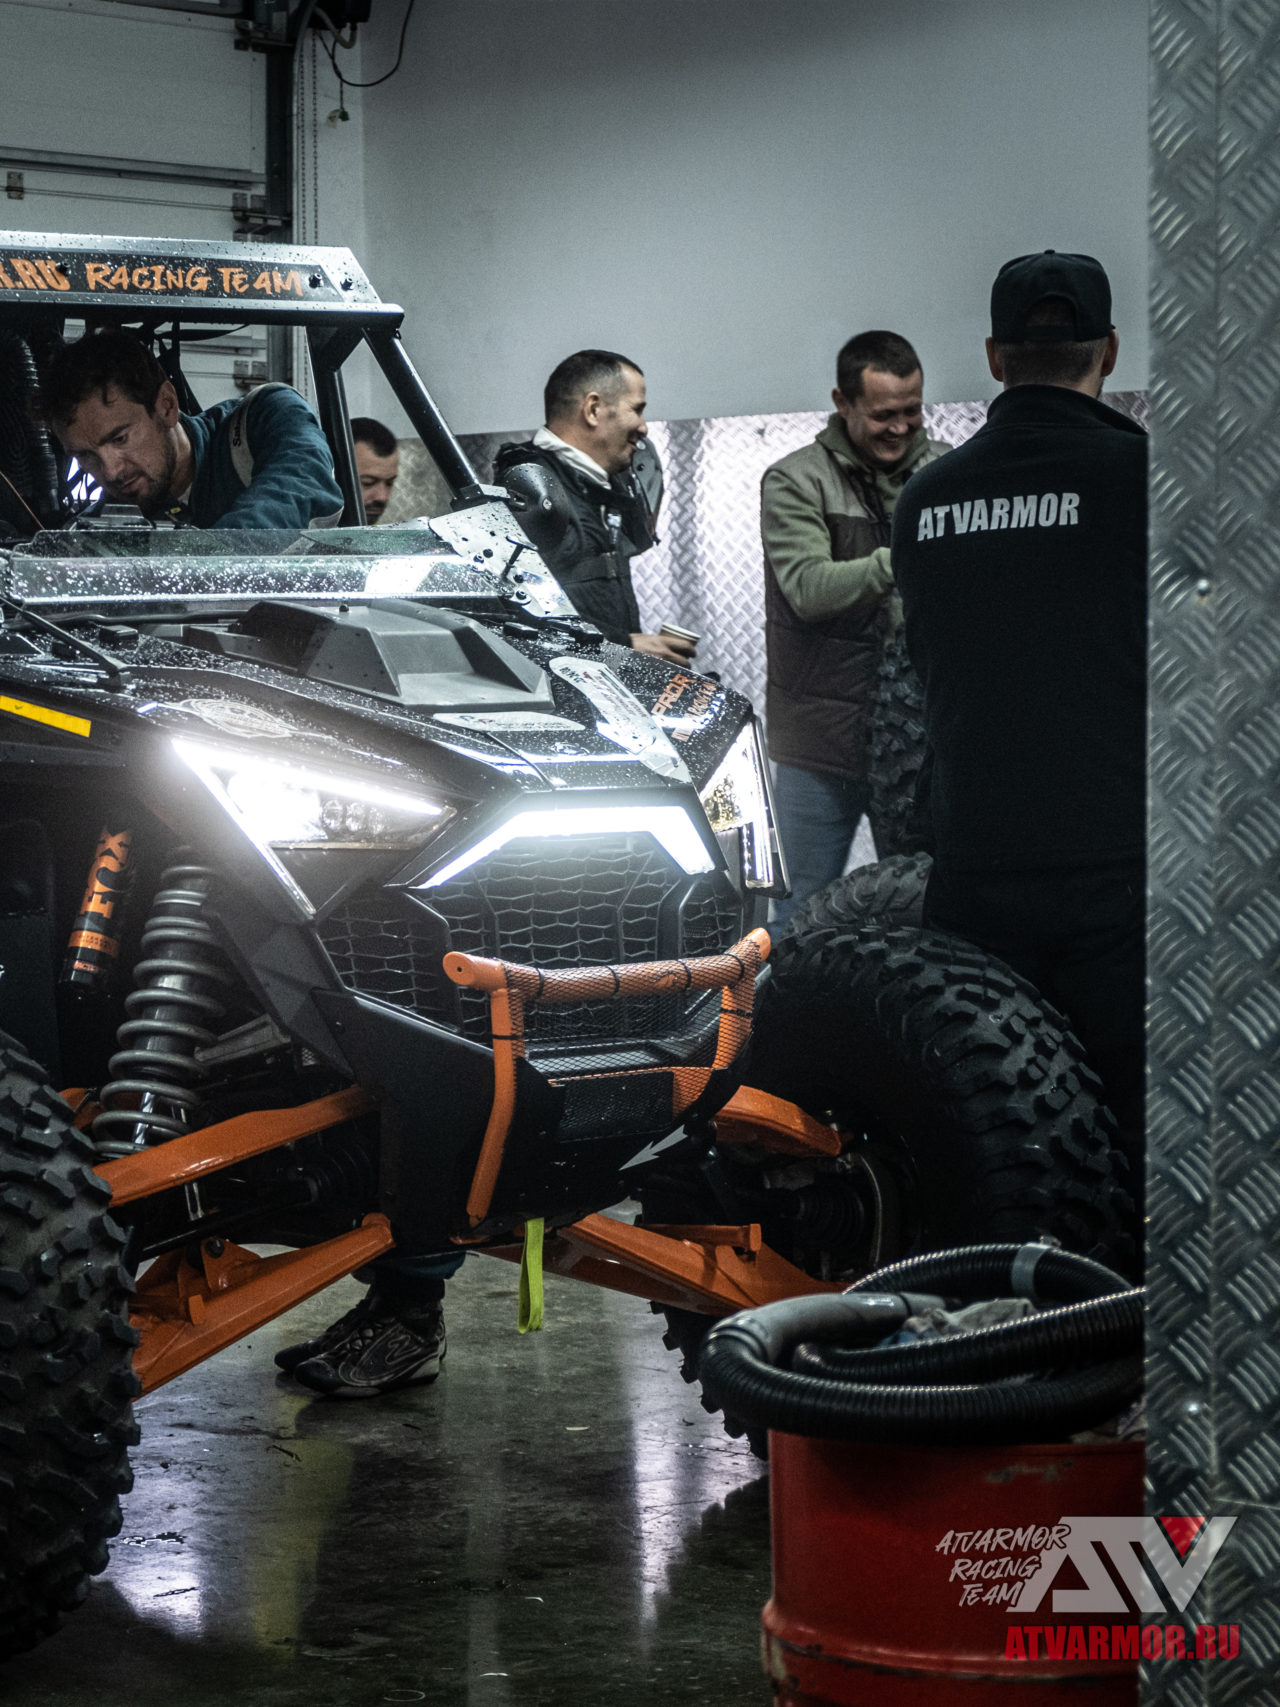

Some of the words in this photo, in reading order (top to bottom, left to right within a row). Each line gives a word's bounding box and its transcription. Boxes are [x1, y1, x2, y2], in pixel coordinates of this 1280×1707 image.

[85, 262, 212, 291] RACING
[217, 267, 304, 297] TEAM
[917, 492, 1080, 541] ATVARMOR
